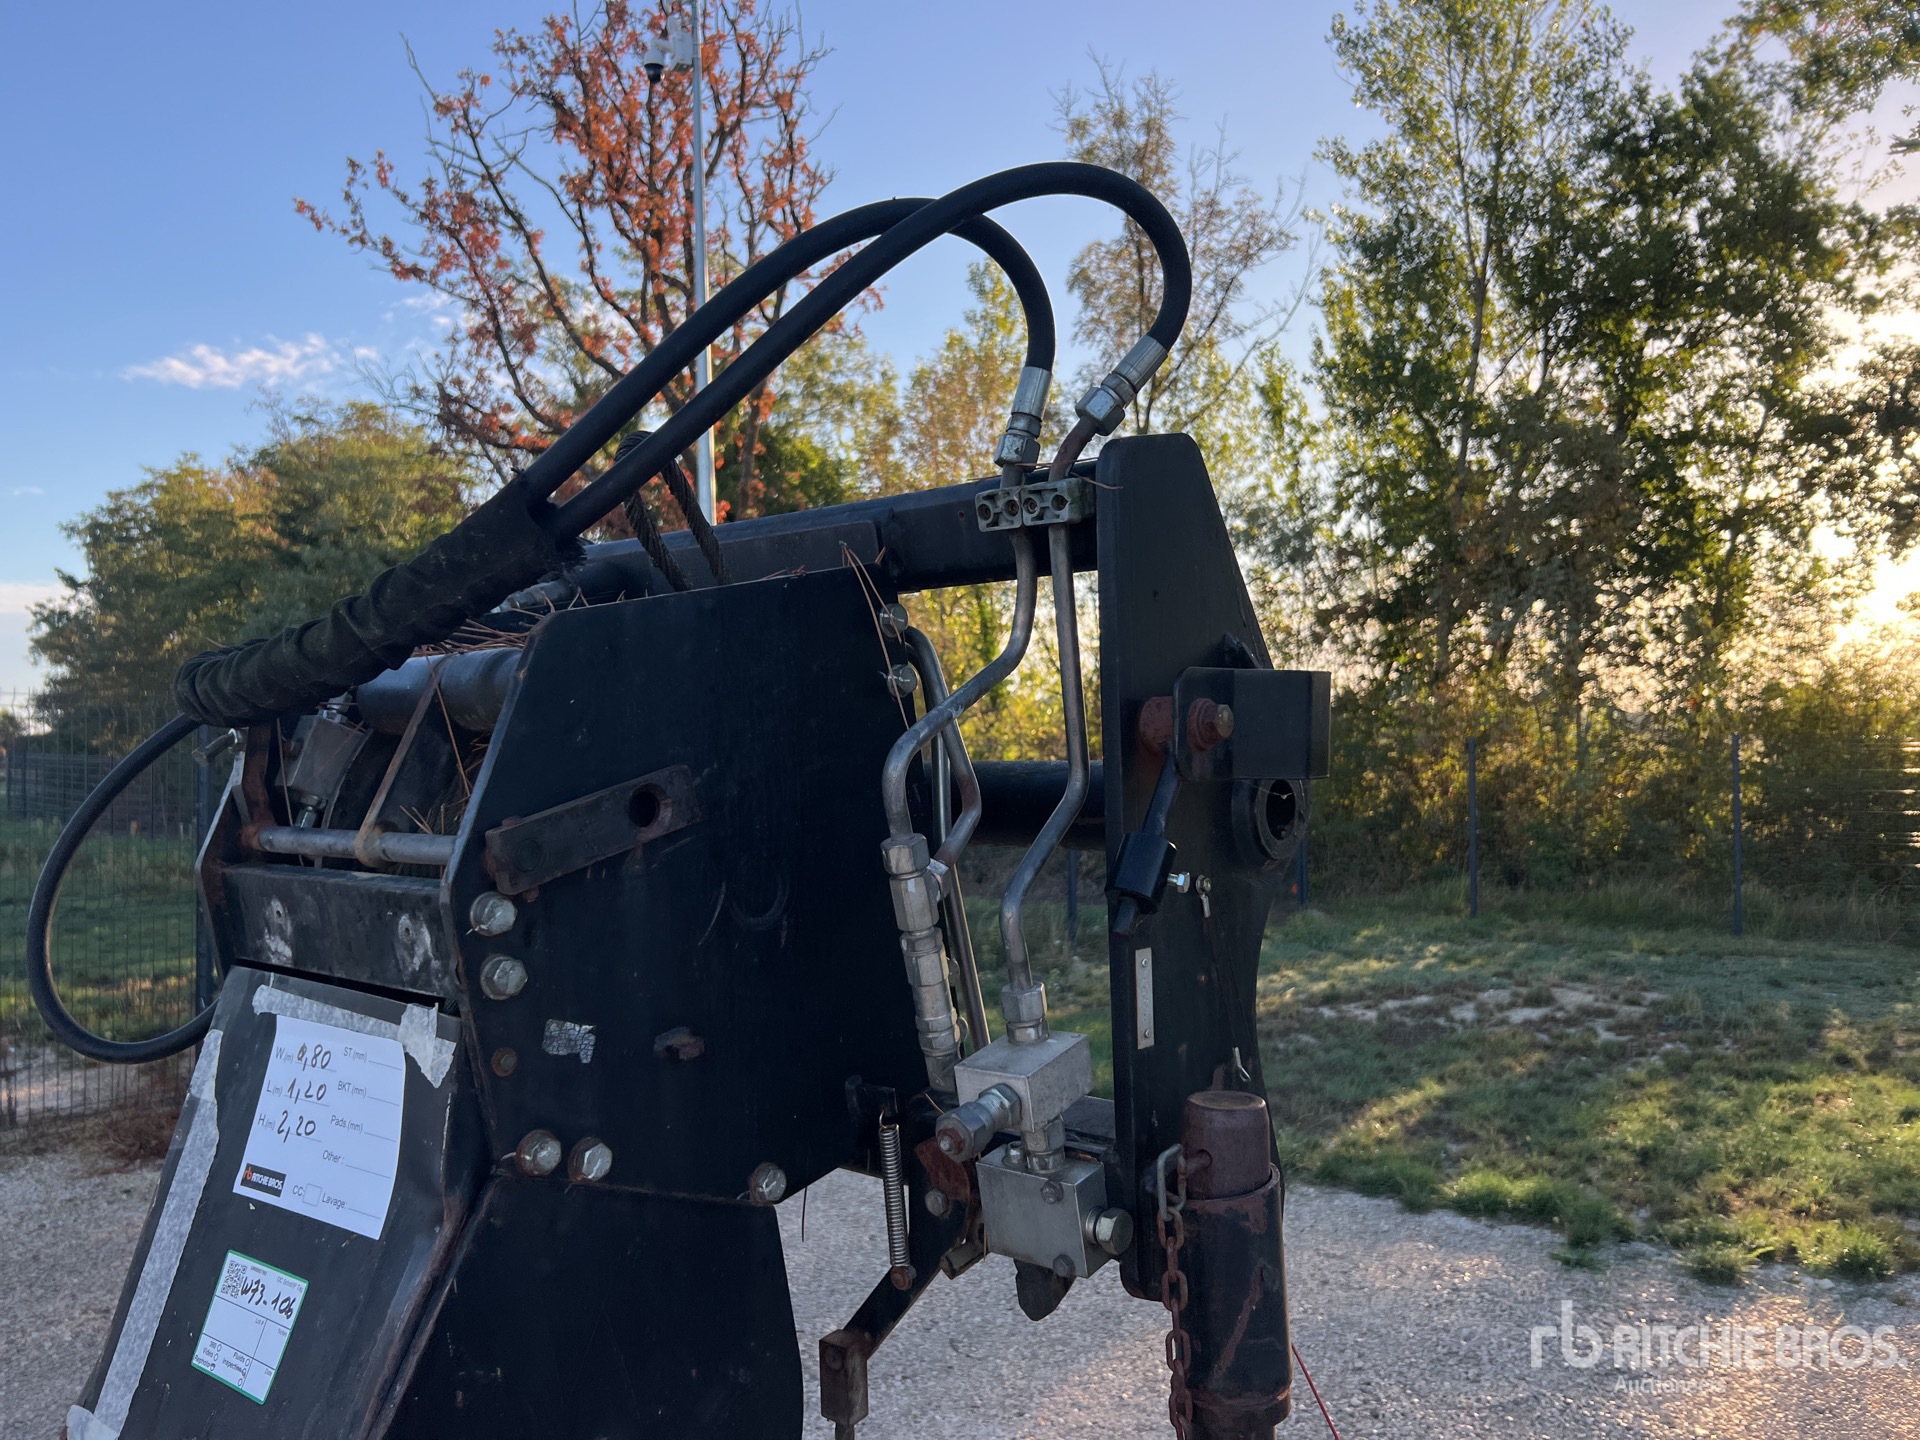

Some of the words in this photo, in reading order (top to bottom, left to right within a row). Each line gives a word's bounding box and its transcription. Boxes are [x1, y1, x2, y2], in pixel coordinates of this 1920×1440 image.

[287, 1078, 327, 1104] 1,20
[277, 1110, 316, 1143] 2,20
[232, 1352, 246, 1364] Fluids
